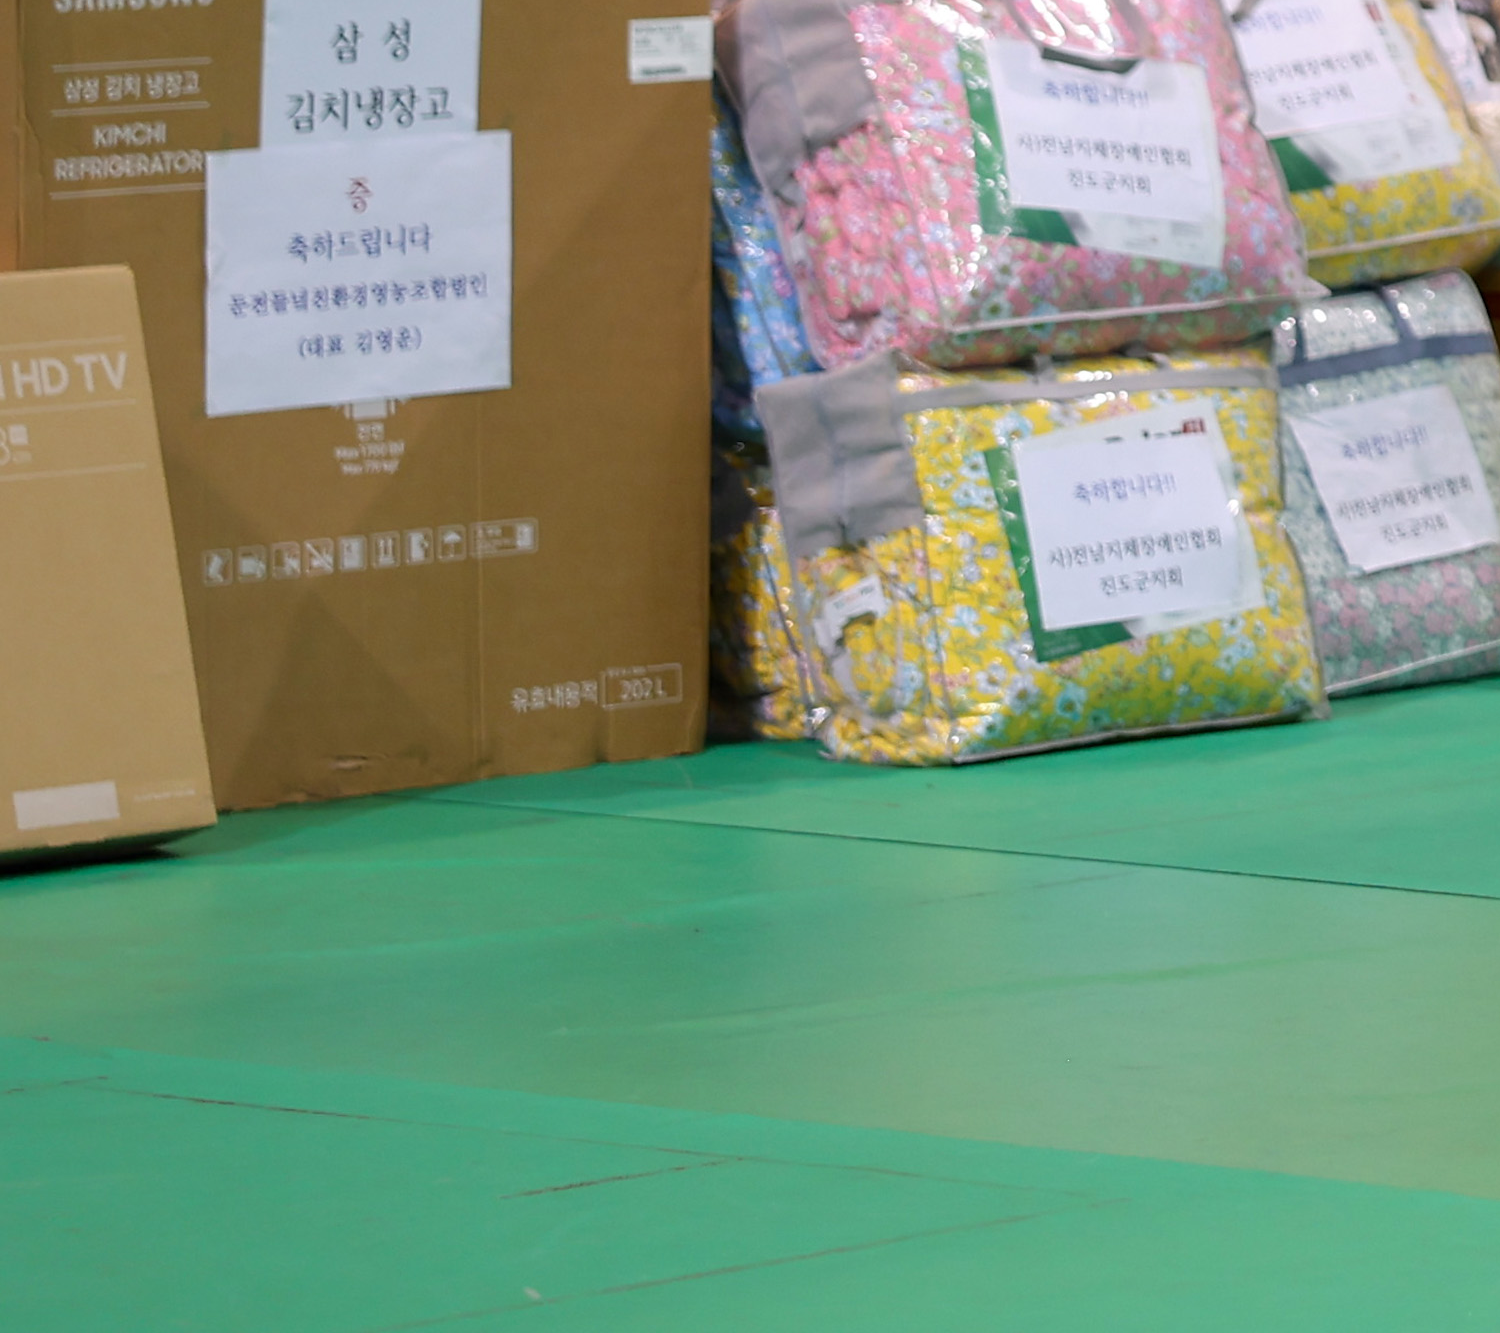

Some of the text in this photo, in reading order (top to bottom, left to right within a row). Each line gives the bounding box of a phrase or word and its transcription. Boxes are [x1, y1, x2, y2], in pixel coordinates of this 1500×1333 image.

[64, 70, 201, 104] 삼성 김치 냉장고
[286, 85, 455, 133] 김치냉장고
[93, 121, 167, 149] KIMCHI
[54, 149, 206, 181] REFRIGERATOR
[346, 176, 373, 214] 증
[288, 222, 433, 264] 축하드립니다
[12, 351, 128, 398] HD TV
[1072, 471, 1177, 505] 축하합니다!!
